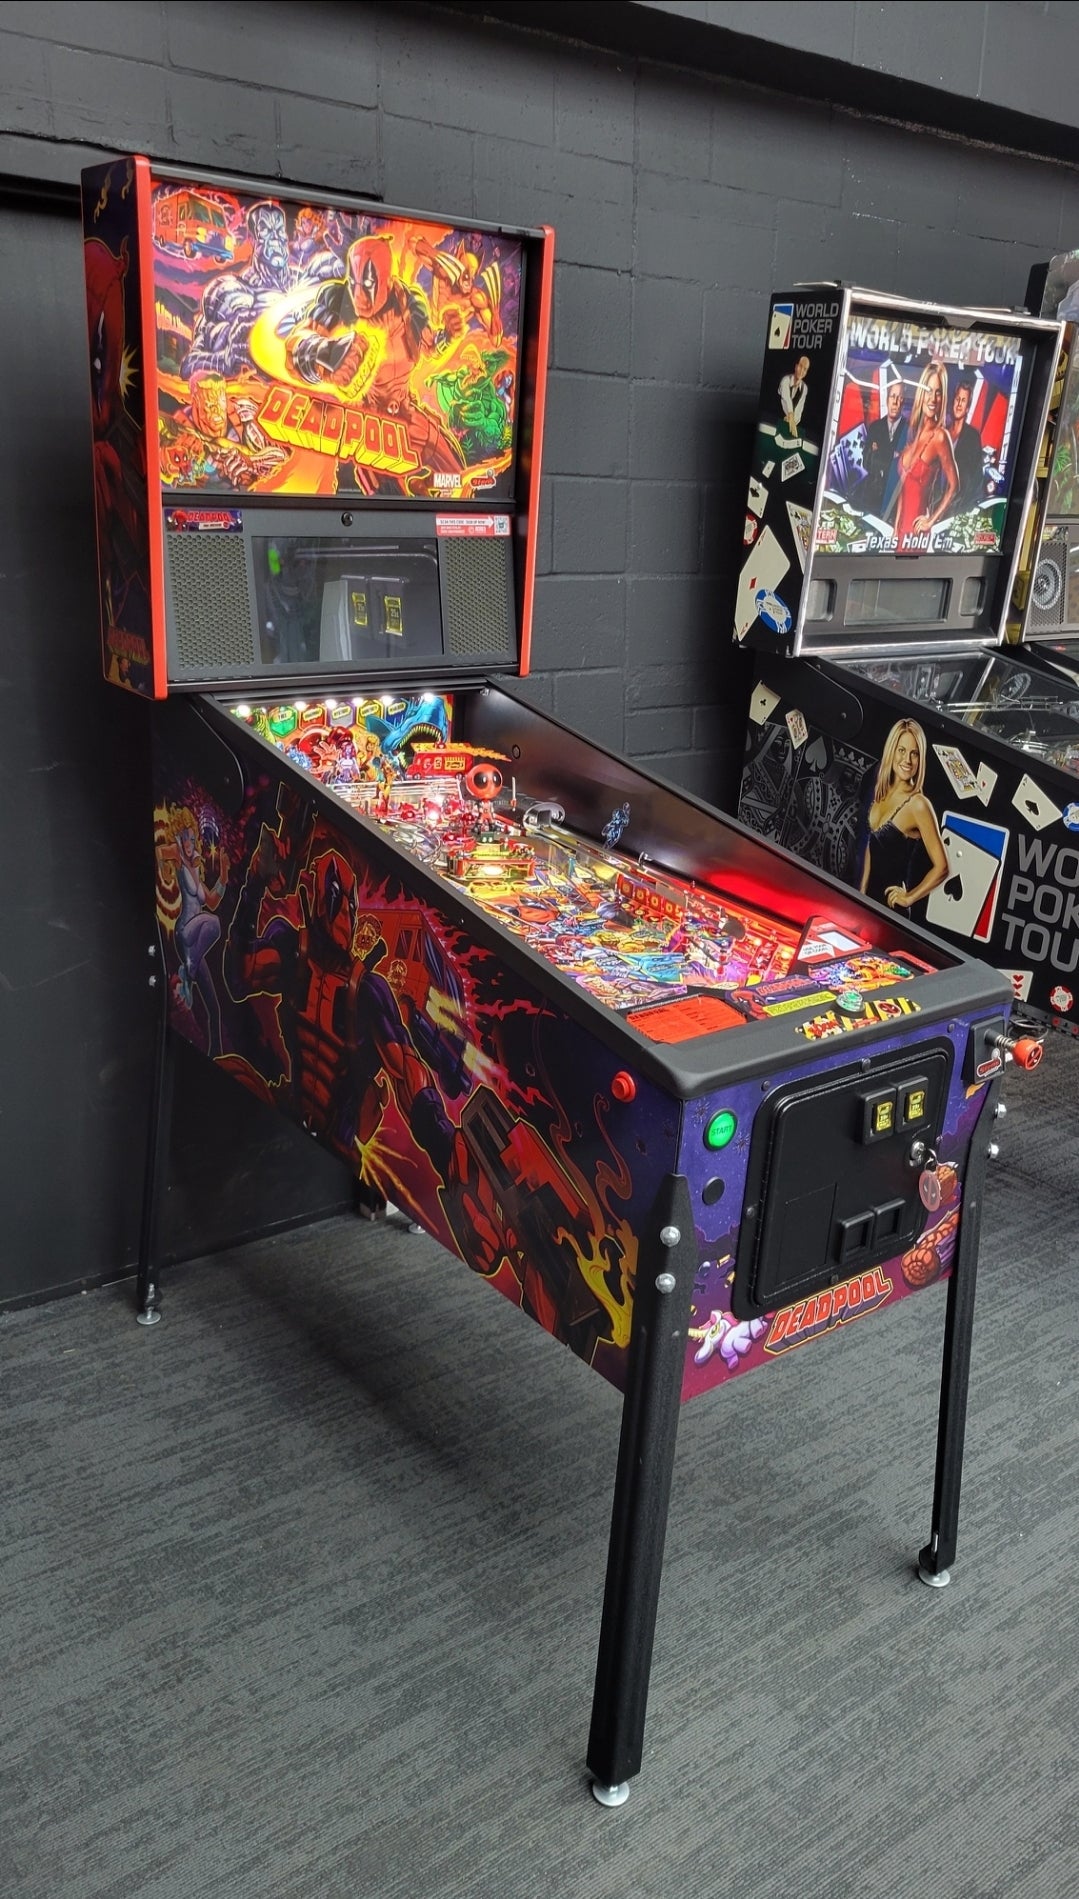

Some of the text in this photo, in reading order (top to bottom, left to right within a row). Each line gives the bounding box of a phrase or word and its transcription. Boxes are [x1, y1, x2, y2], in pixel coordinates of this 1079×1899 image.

[795, 302, 840, 318] WORLD
[793, 319, 833, 333] POKER
[792, 334, 823, 349] TOUR
[850, 321, 912, 353] WORLD
[975, 334, 1018, 365] TOUR
[257, 386, 420, 475] DEADPOOL
[433, 472, 462, 488] MARVEL
[865, 532, 898, 550] Texas
[902, 533, 928, 549] Hold
[711, 1125, 732, 1136] START
[764, 1266, 893, 1355] DEADPOOL
